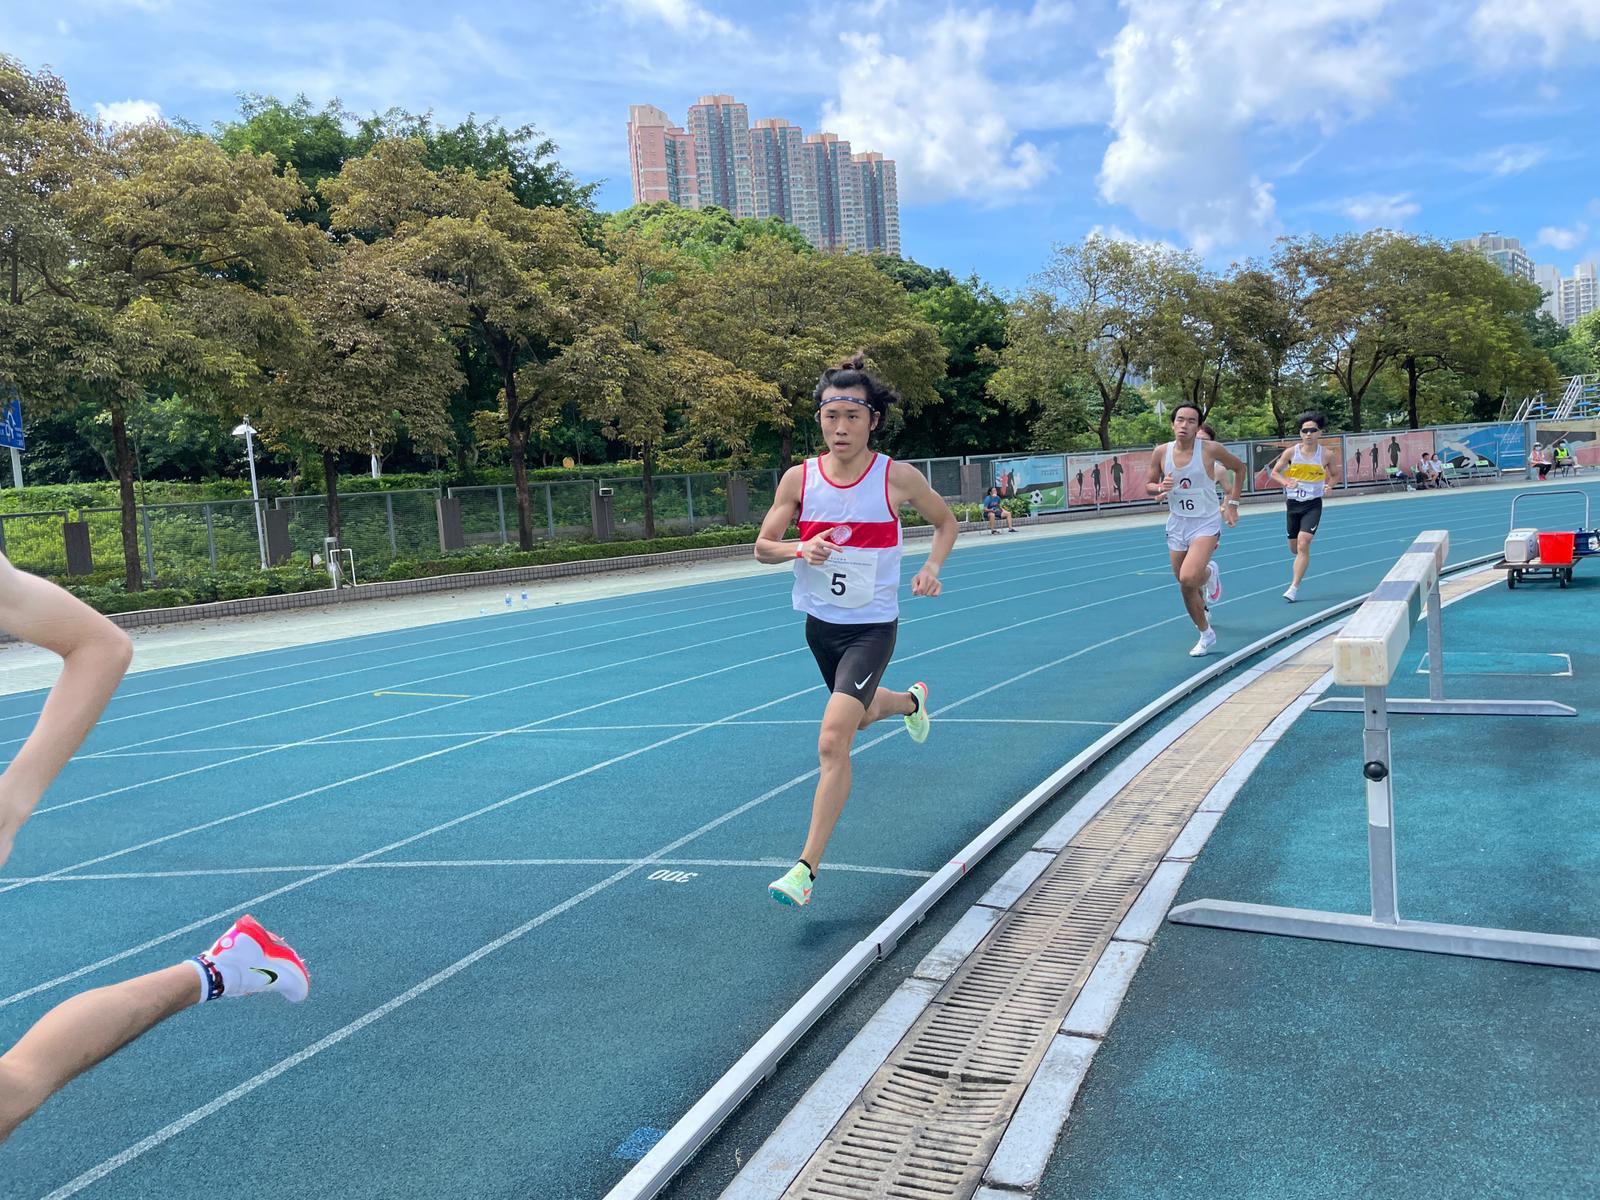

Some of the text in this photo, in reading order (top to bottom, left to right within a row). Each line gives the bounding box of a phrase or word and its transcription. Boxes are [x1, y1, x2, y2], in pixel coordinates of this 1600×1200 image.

[1296, 489, 1307, 498] 10
[1178, 499, 1195, 511] 16
[831, 572, 847, 596] 5
[647, 868, 699, 883] 300
